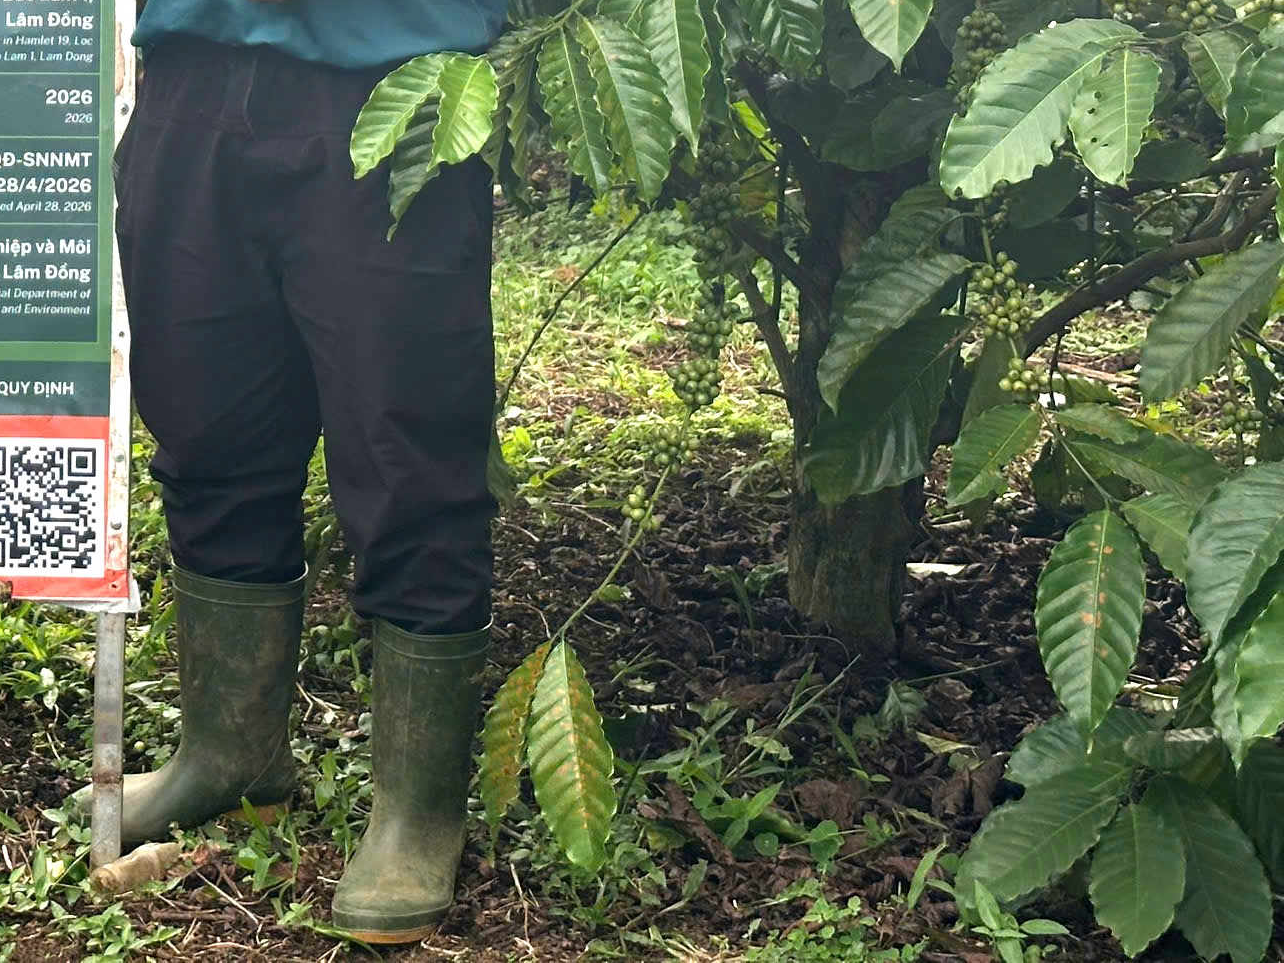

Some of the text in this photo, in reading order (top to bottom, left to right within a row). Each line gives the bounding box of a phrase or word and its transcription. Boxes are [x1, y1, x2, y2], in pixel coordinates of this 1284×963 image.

[6, 10, 93, 29] Lâm Đồng
[3, 37, 12, 46] in
[16, 34, 54, 46] Hamlet
[75, 36, 92, 46] Loc
[4, 50, 27, 61] Lam
[40, 50, 62, 61] Lam
[66, 50, 93, 64] Dong
[46, 90, 92, 104] 2026
[65, 112, 92, 124] 2026
[16, 200, 41, 213] April
[64, 200, 91, 212] 2026
[36, 239, 54, 253] và
[60, 239, 90, 254] Môi
[3, 265, 40, 279] Lâm
[45, 263, 91, 283] Đồng
[14, 287, 77, 301] Department
[80, 288, 91, 300] of
[1, 303, 21, 314] and
[24, 303, 90, 315] Environment
[34, 382, 74, 397] ĐỊNH
